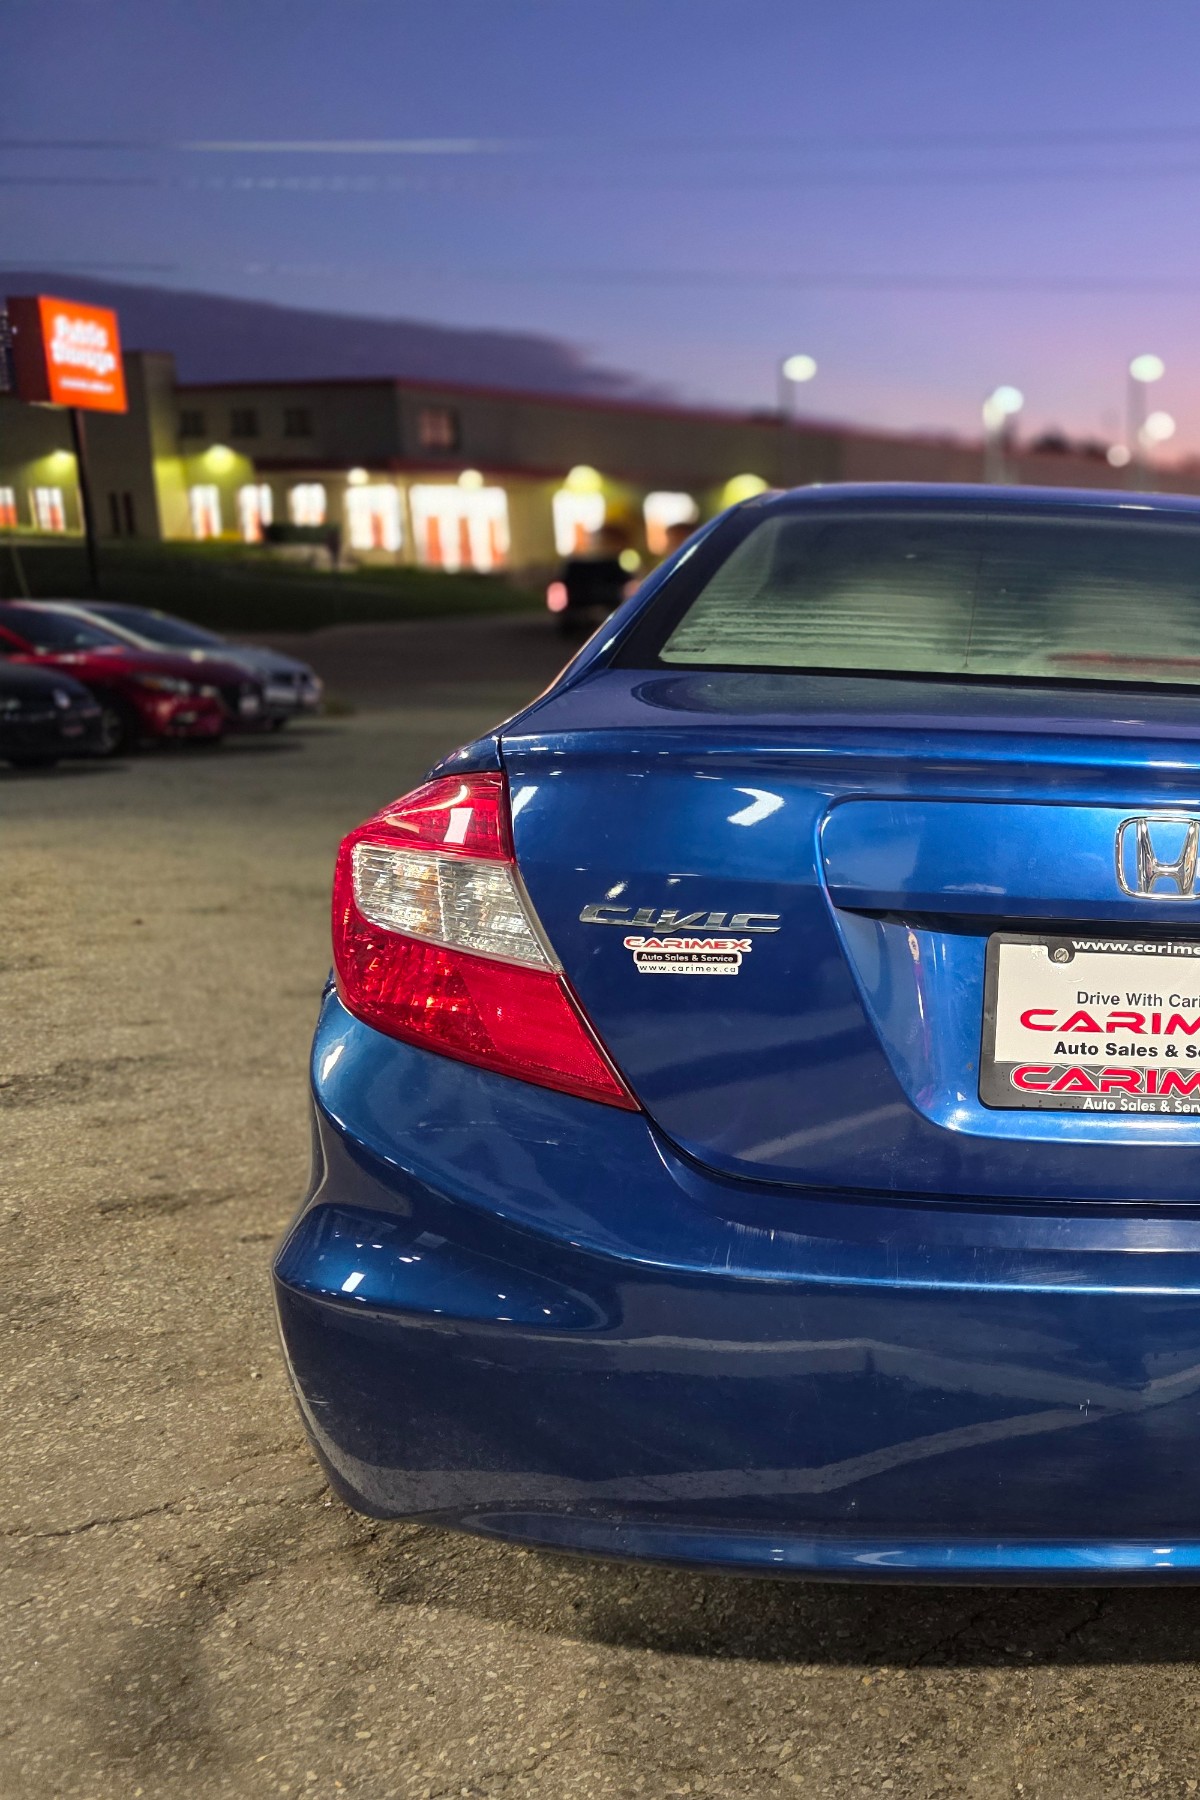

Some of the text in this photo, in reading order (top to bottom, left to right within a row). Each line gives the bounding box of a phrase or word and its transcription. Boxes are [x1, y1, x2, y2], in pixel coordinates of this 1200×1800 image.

[579, 904, 781, 934] CIVIC
[625, 938, 751, 950] CARIMEX
[641, 953, 734, 963] Auto Sales & Service
[639, 964, 736, 973] www.carimex.ca
[1077, 991, 1120, 1006] Drive
[1126, 992, 1163, 1007] With
[1054, 1041, 1099, 1056] Auto
[1105, 1042, 1158, 1058] Sales
[1164, 1044, 1177, 1058] &
[1083, 1097, 1116, 1112] Auto
[1120, 1099, 1156, 1112] Sales
[1161, 1100, 1171, 1113] &
